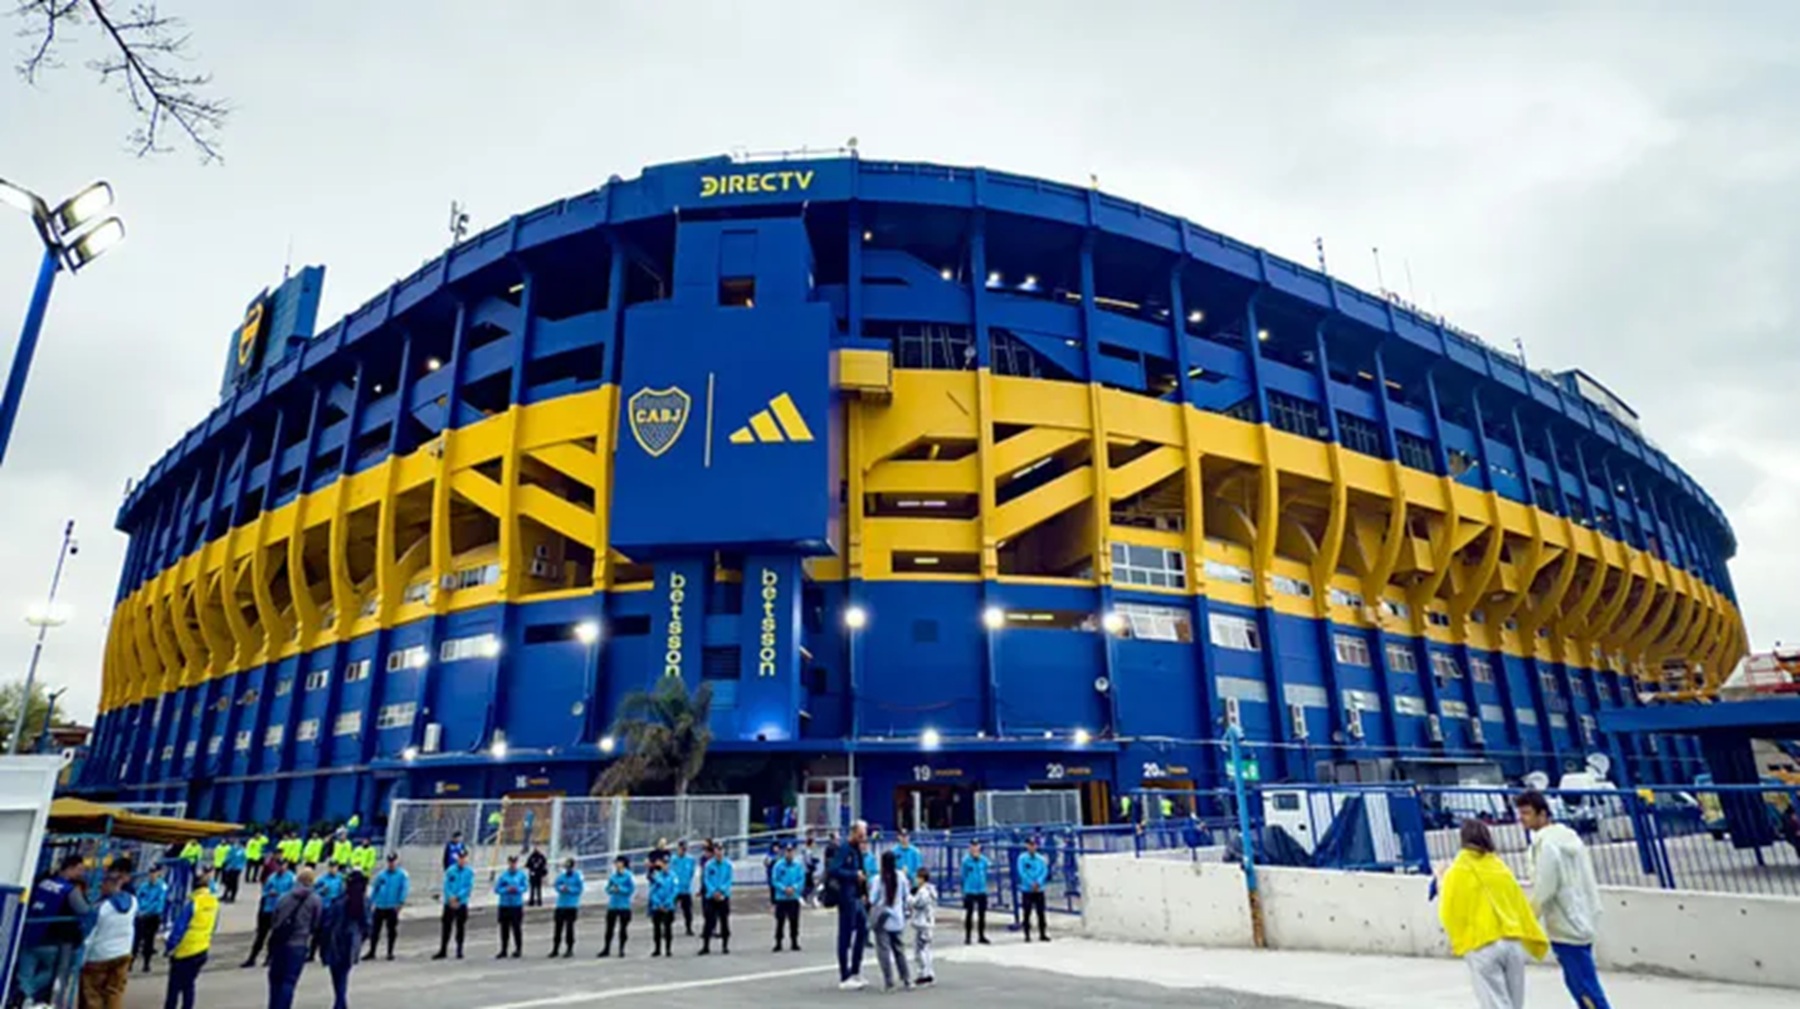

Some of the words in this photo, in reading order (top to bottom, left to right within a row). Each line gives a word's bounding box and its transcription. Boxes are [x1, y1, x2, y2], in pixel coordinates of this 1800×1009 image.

[699, 169, 815, 198] DIRECTV
[636, 408, 681, 424] CABJ
[665, 571, 686, 678] betsson
[759, 567, 778, 677] betsson
[912, 764, 931, 781] 19
[1045, 762, 1065, 779] 20
